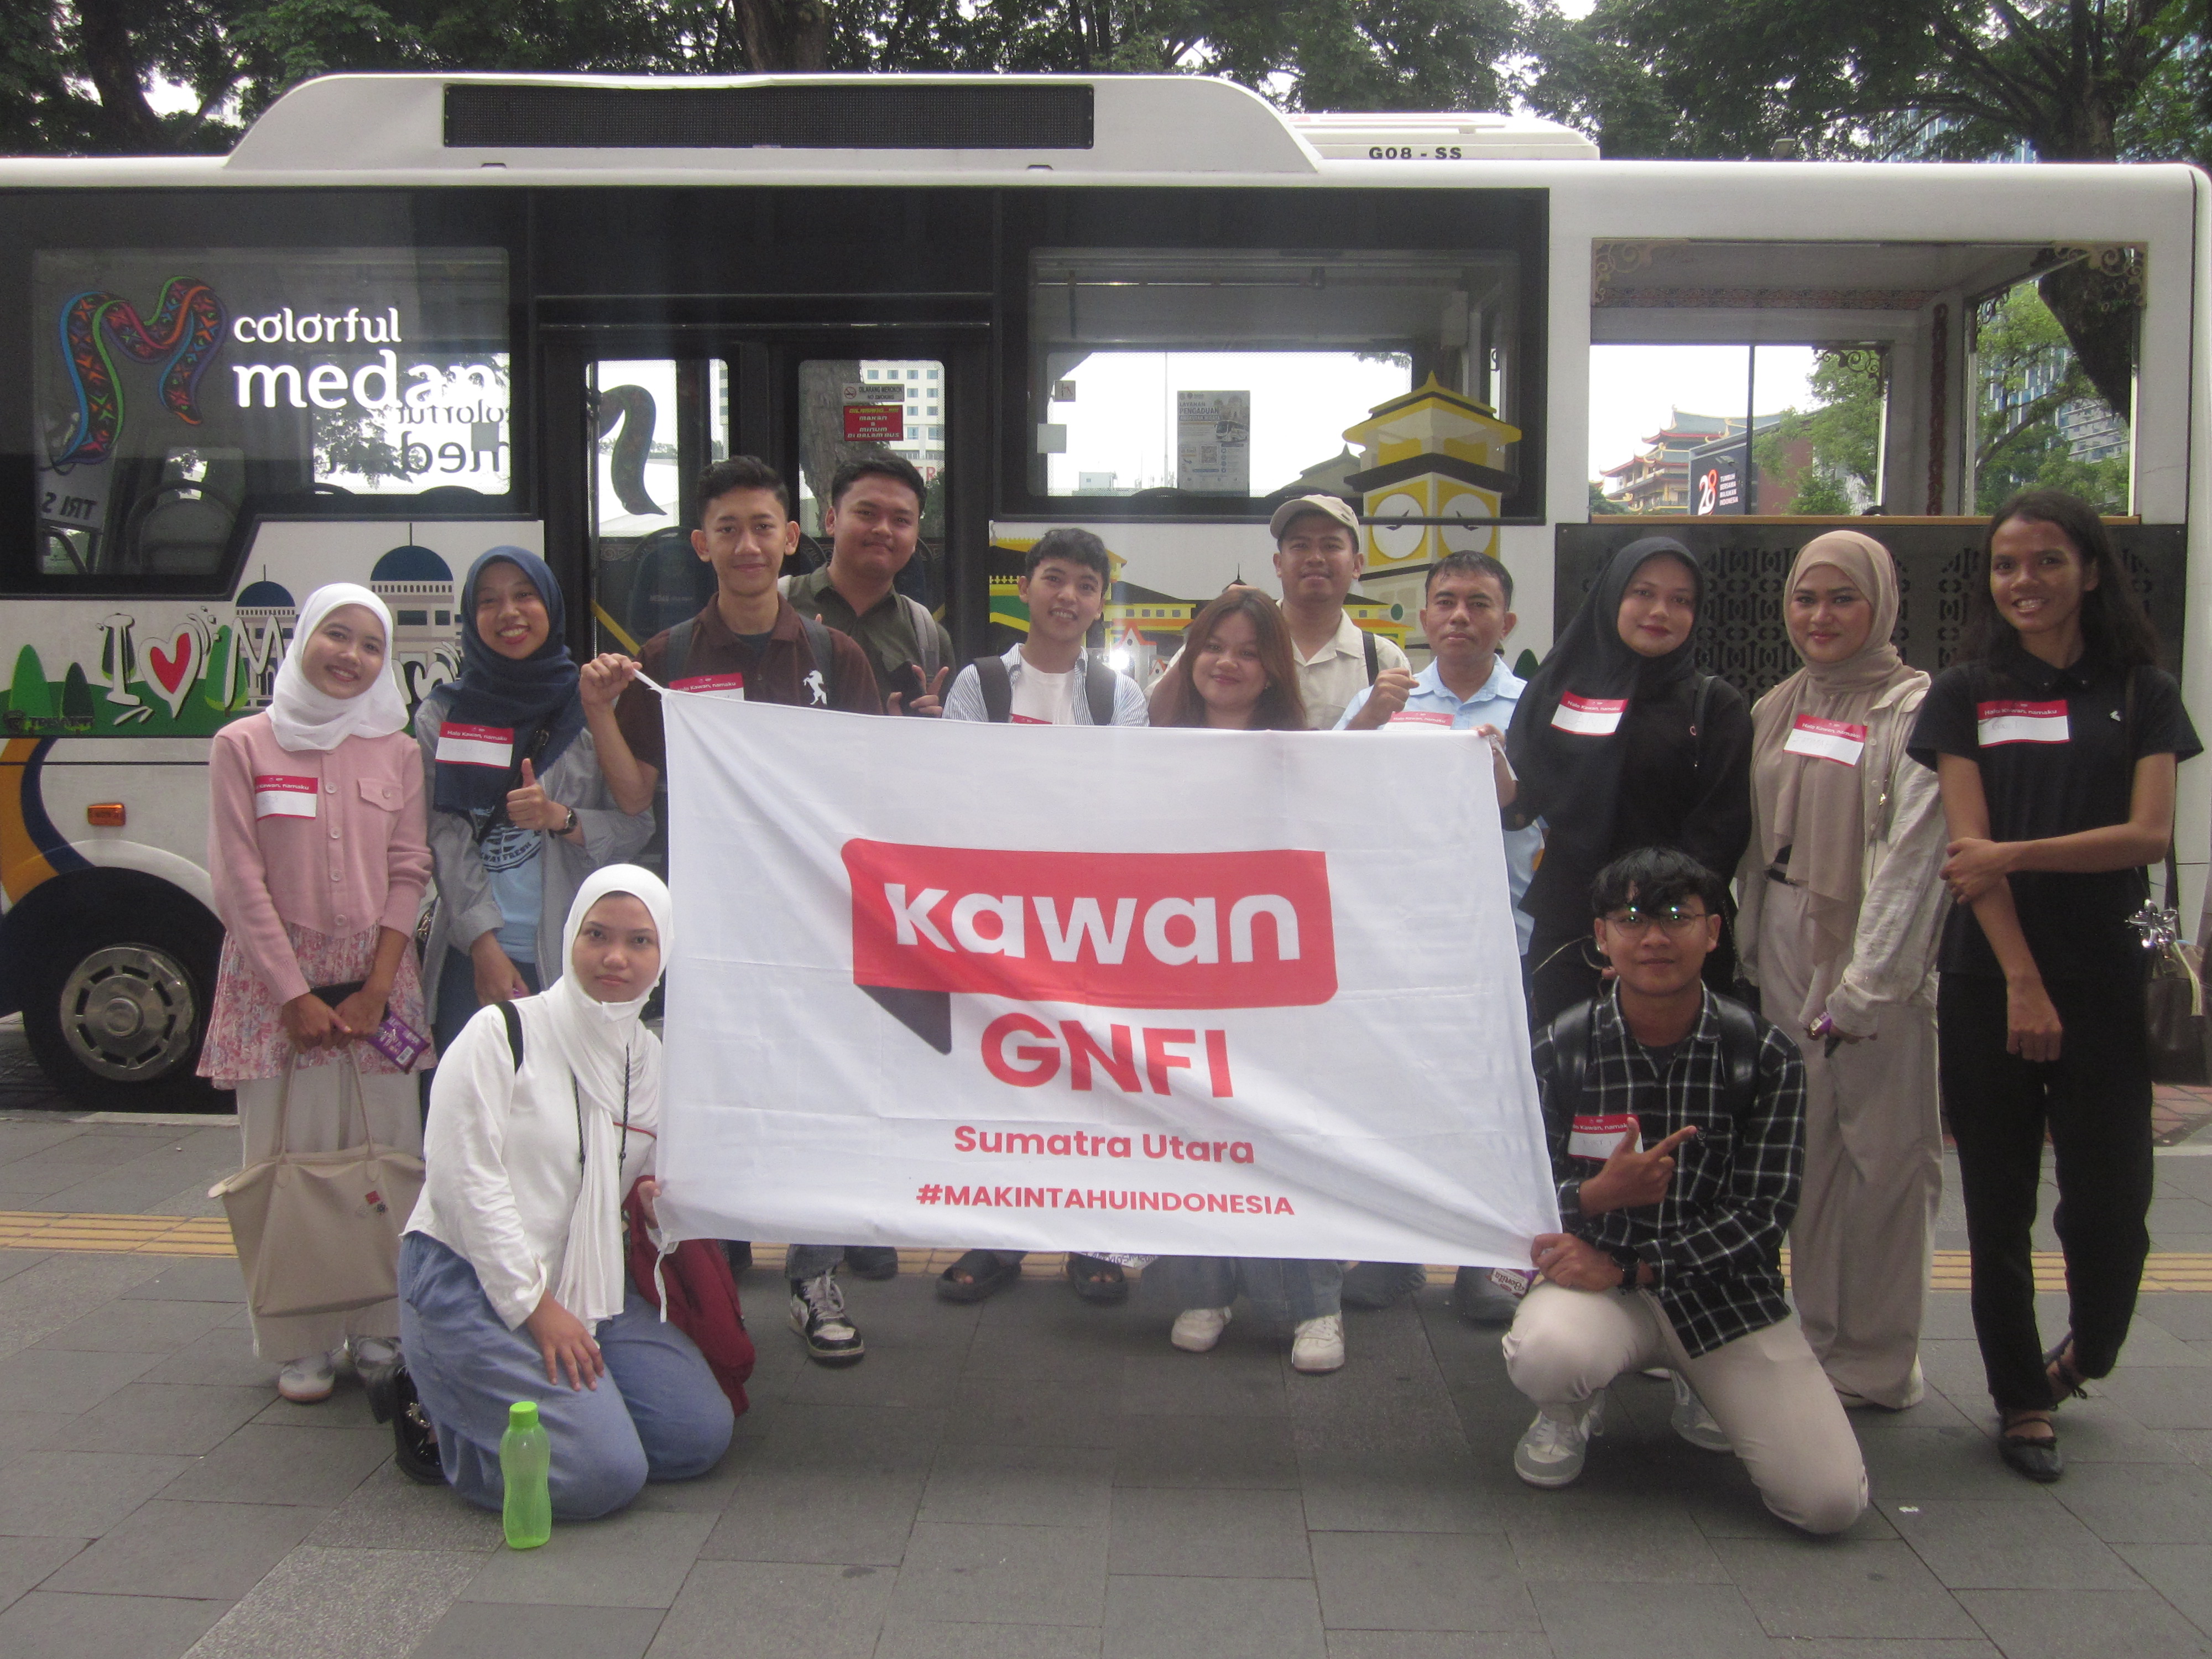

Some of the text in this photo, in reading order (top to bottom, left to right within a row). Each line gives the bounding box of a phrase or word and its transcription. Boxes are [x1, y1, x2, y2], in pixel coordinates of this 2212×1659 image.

[1434, 147, 1462, 160] SS
[233, 307, 401, 343] colorful
[233, 349, 499, 409] medan
[1698, 469, 1717, 515] 28
[980, 1012, 1234, 1098] GNFI
[954, 1125, 1255, 1165] Sumatra Utara
[916, 1183, 1295, 1215] #MAKINTAHUINDONESIA
